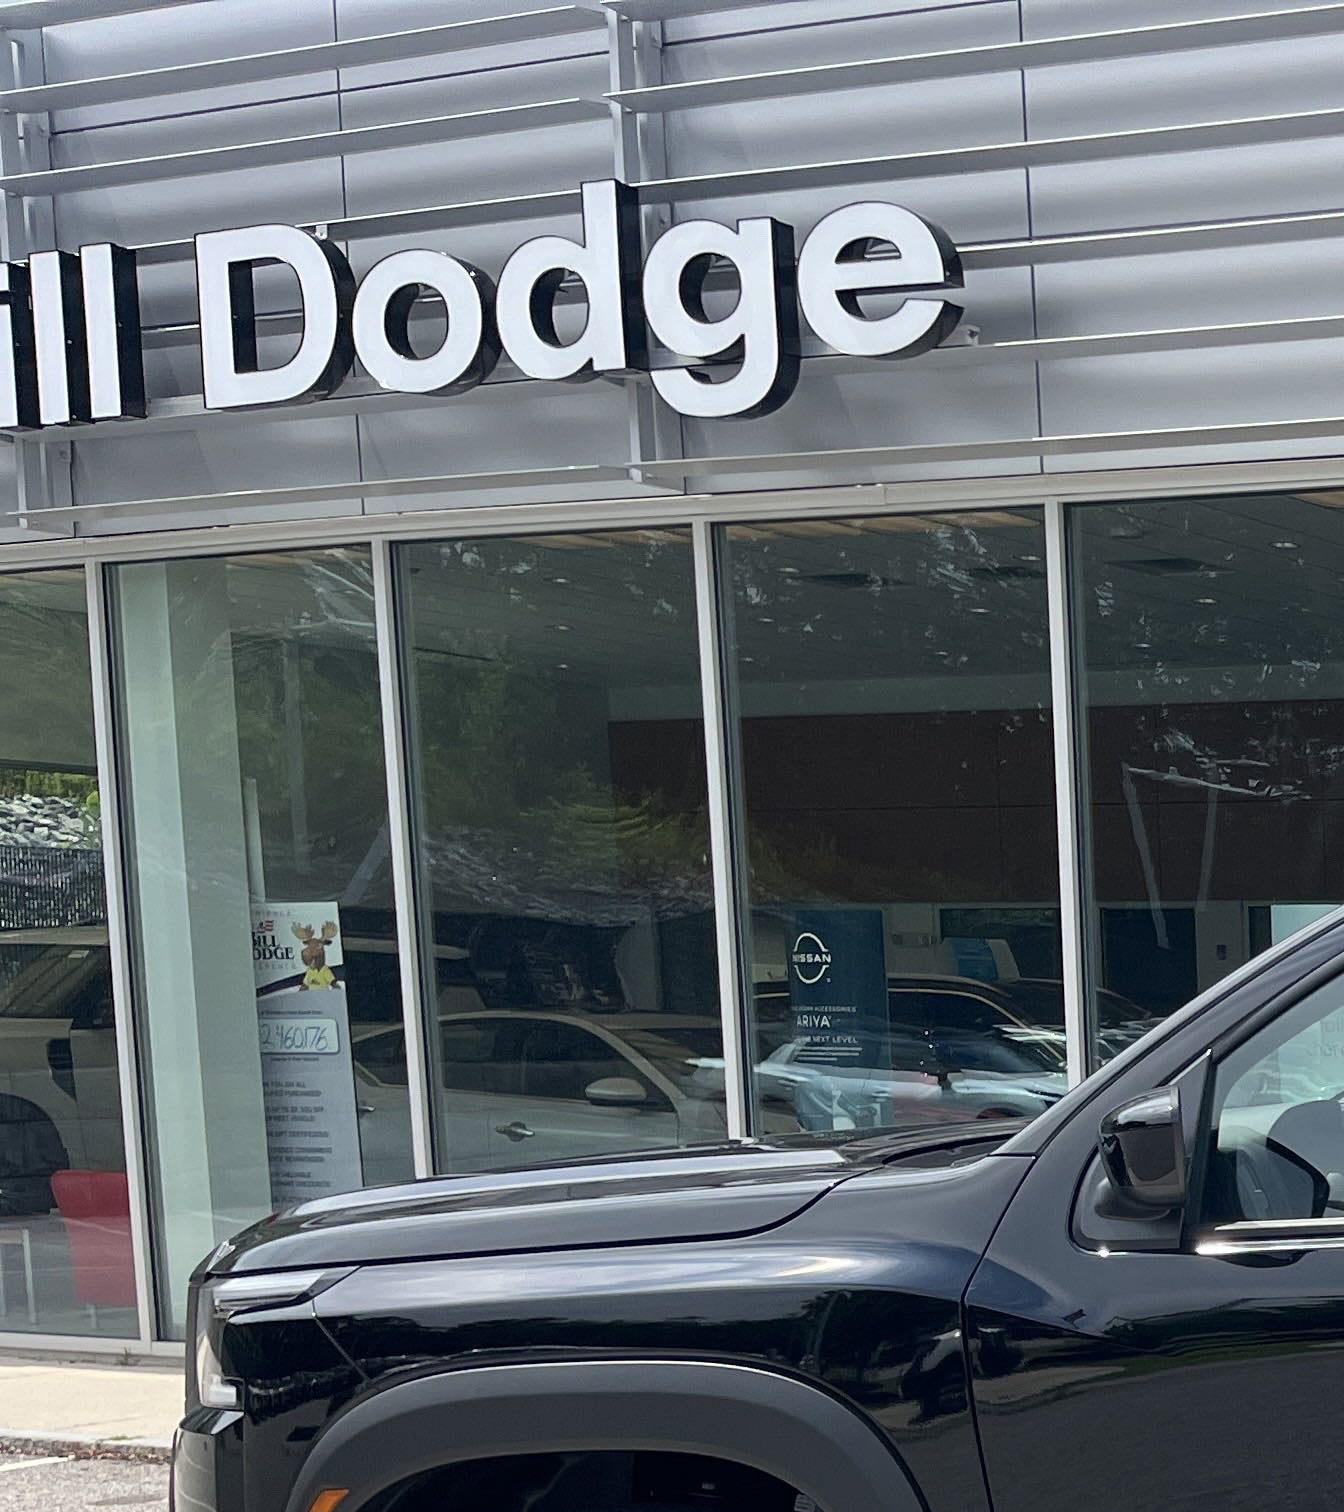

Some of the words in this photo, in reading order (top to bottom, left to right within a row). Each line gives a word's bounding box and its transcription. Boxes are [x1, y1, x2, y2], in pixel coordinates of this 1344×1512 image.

[195, 179, 958, 417] Dodge
[253, 946, 295, 960] ODGE
[792, 953, 831, 963] NISSAN
[797, 1015, 831, 1028] ARIYA
